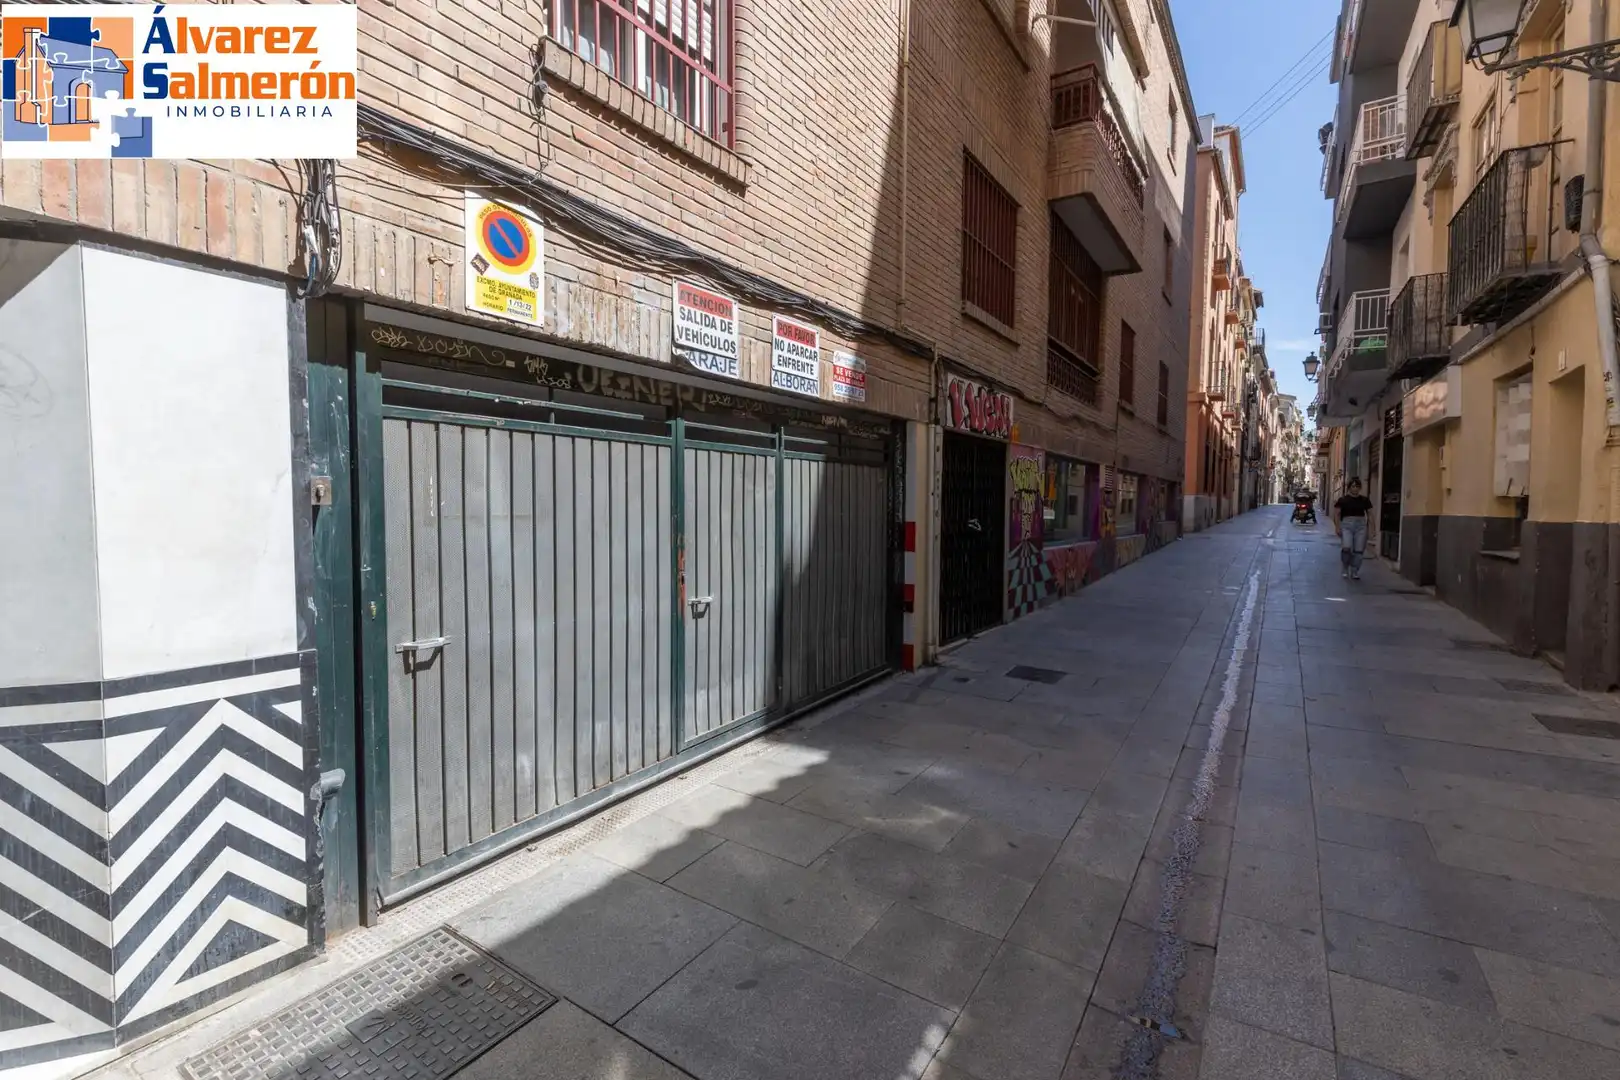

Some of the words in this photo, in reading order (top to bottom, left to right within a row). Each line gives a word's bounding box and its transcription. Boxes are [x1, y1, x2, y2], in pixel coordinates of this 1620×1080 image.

[488, 285, 497, 294] DE
[497, 288, 523, 301] GRANADA
[498, 281, 536, 299] AYUNTAMIENTO
[679, 305, 718, 331] SALIDA
[720, 318, 734, 335] DE
[676, 324, 737, 355] VEHÍCULOS
[778, 322, 793, 338] POR
[794, 327, 816, 346] FAVOR
[774, 337, 785, 352] NO
[786, 342, 819, 362] APARCAR
[673, 348, 738, 377] ARAJE
[777, 354, 815, 376] ENFRENTE
